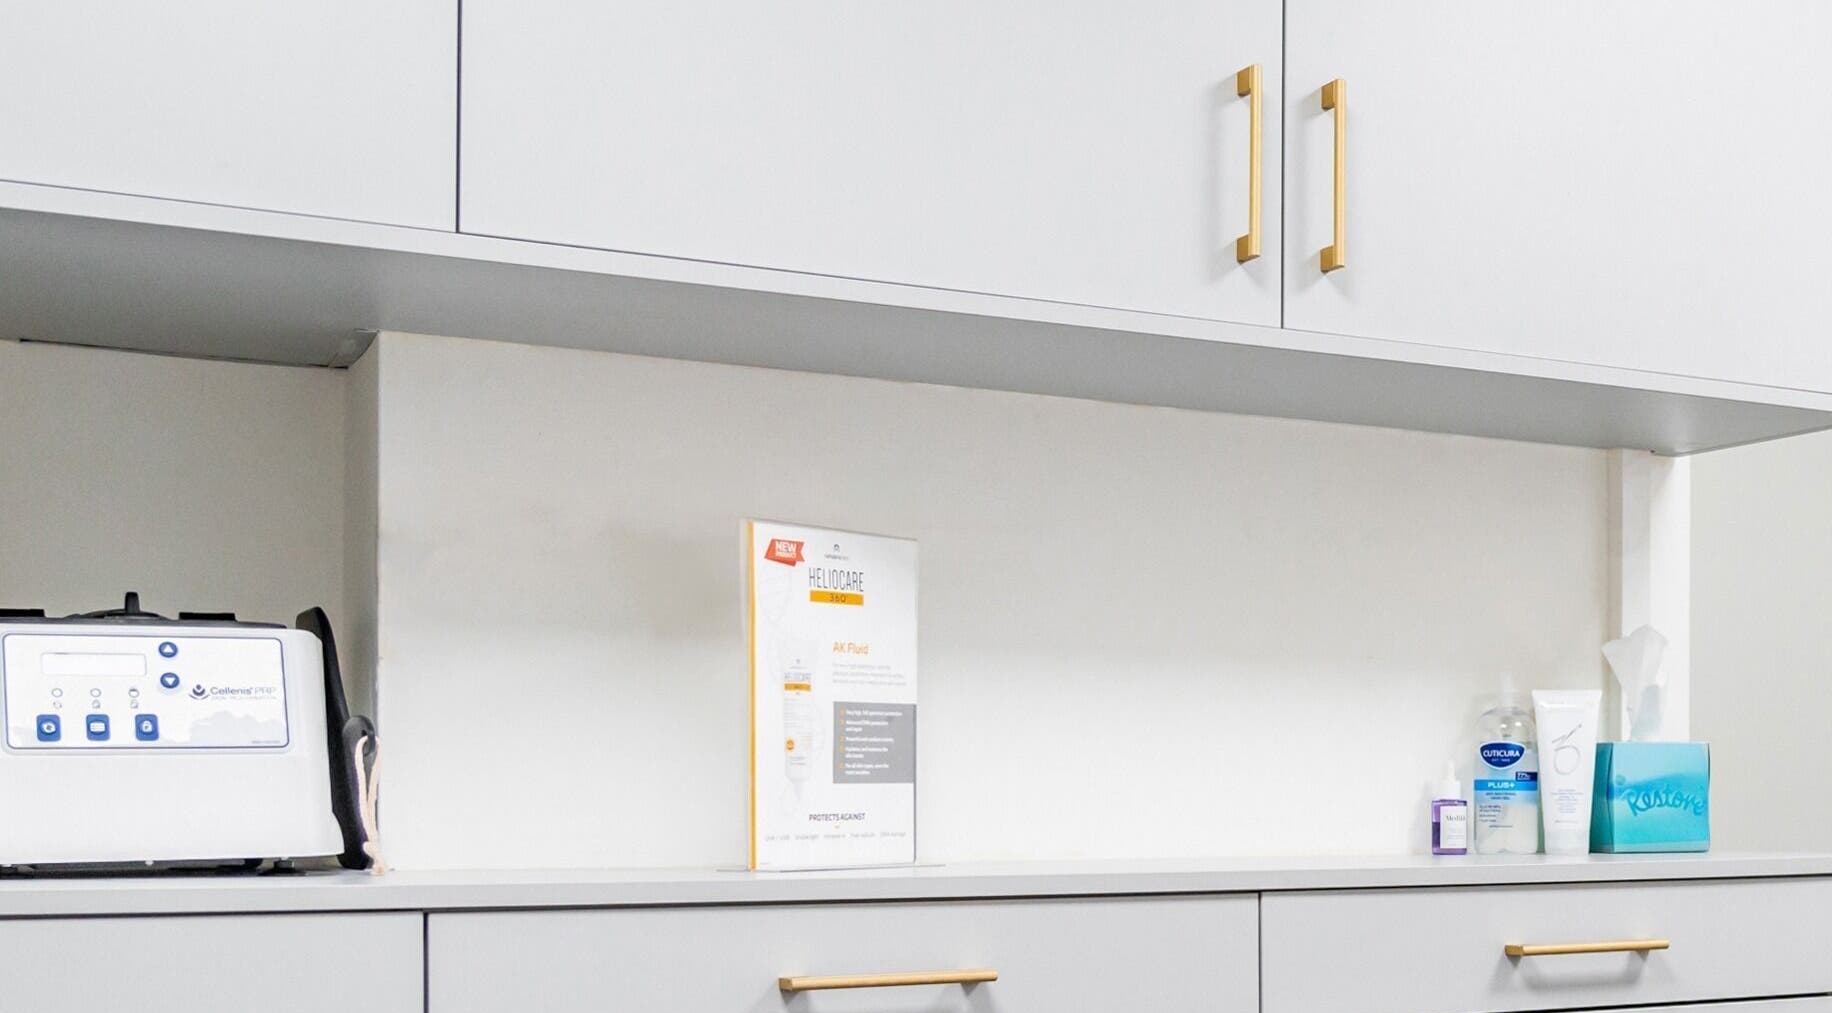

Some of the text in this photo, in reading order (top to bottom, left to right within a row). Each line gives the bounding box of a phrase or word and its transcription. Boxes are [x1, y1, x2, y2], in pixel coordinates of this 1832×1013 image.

[775, 541, 797, 552] NEW
[808, 568, 865, 592] HELIOCARE
[833, 641, 846, 654] AK
[1482, 749, 1521, 758] CUTICURA
[1622, 784, 1705, 817] Restore
[808, 812, 866, 822] PROTECTS AGAINST
